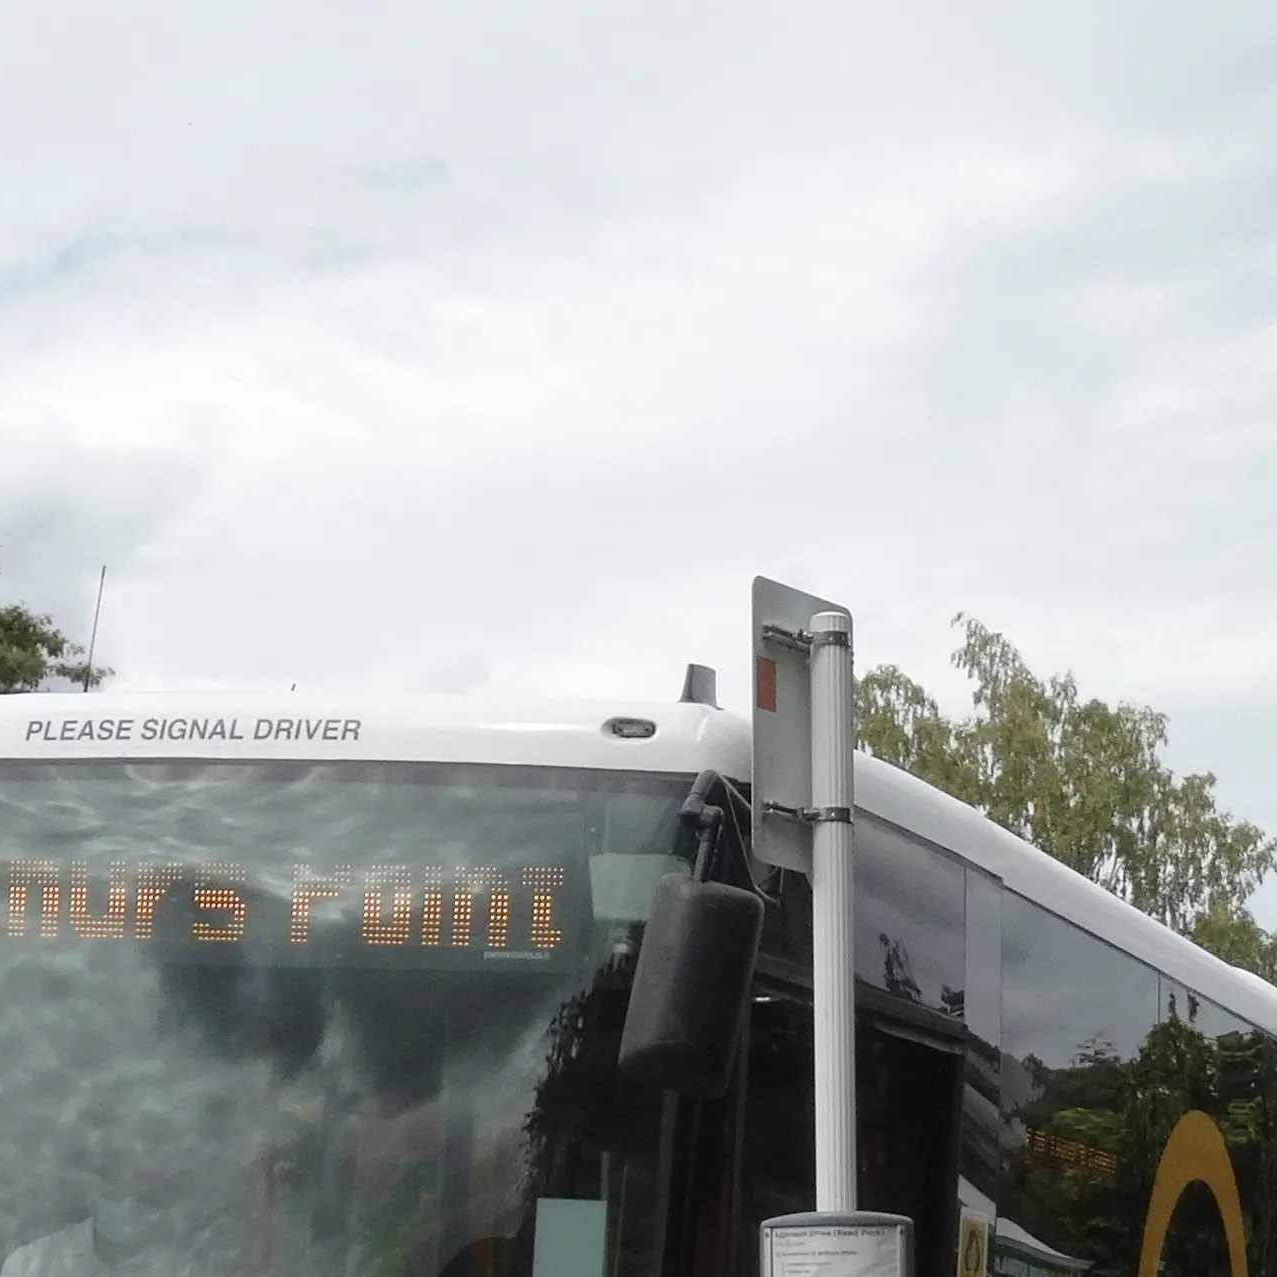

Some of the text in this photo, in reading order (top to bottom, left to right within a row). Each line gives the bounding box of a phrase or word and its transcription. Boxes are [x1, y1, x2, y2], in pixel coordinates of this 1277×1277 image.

[25, 718, 362, 742] PLEASE SIGNAL DRIVER
